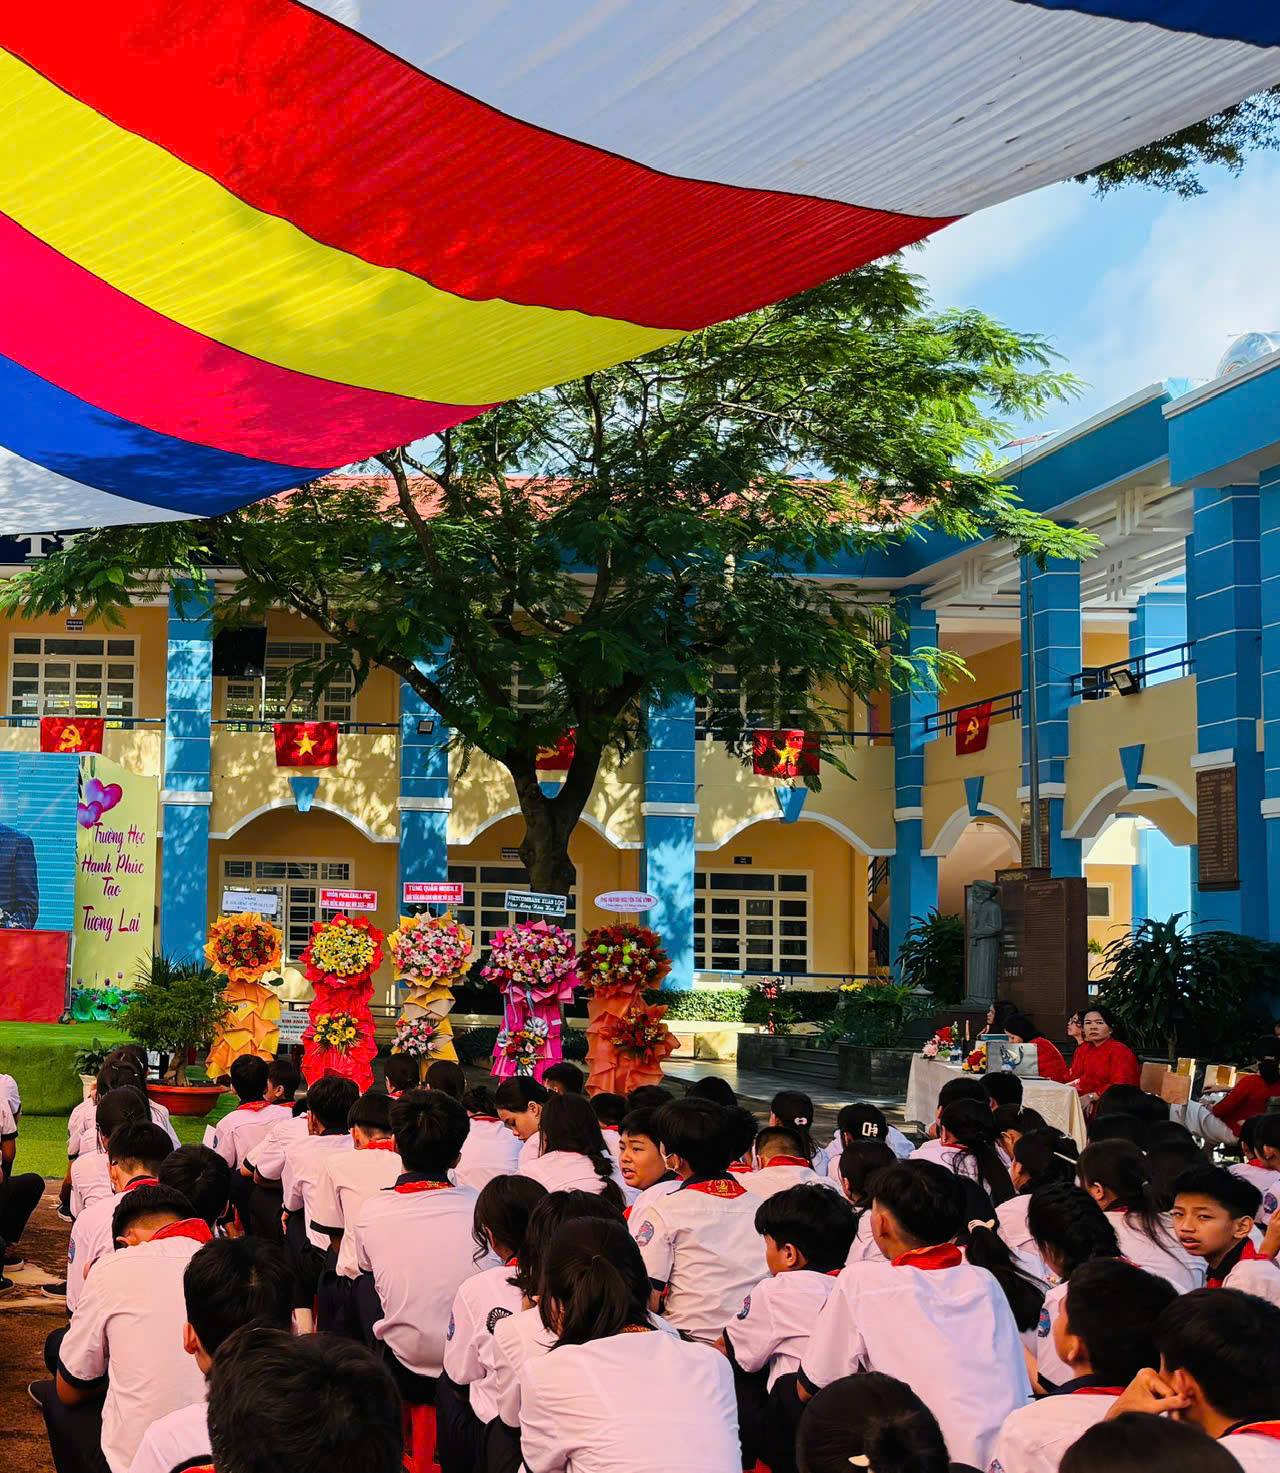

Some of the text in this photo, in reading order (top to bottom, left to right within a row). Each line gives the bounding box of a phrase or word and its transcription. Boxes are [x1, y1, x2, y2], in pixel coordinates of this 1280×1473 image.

[128, 824, 145, 848] Học
[81, 853, 145, 876] Hạnh Phúc
[118, 907, 140, 932] Lai
